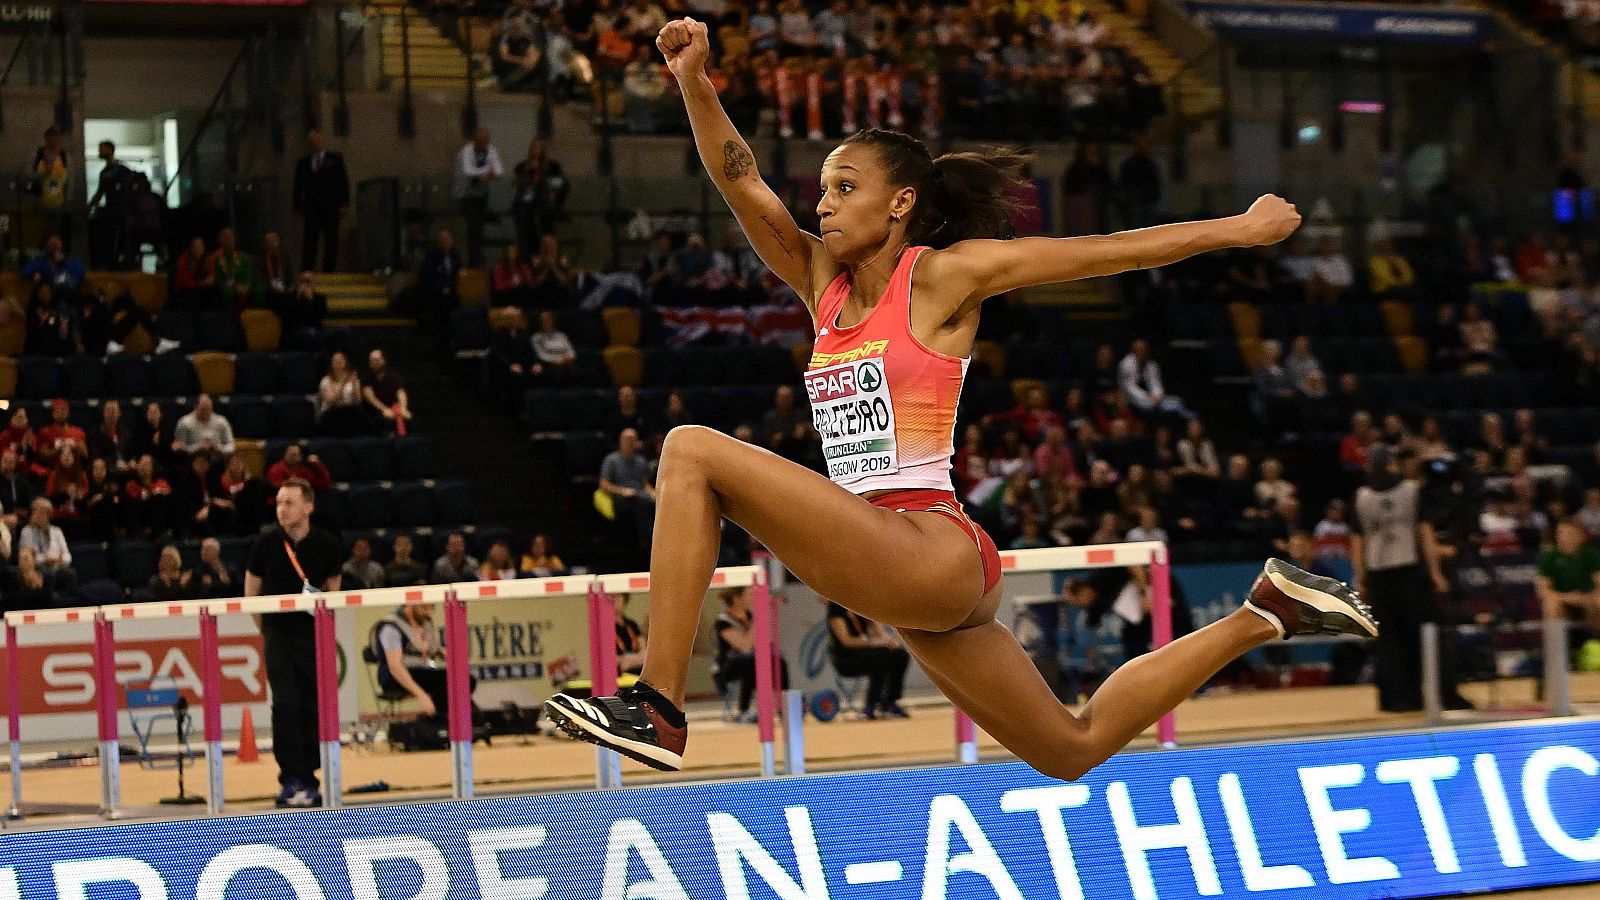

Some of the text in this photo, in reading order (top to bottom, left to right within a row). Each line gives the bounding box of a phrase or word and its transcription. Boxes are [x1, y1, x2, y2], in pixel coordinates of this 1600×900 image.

[805, 370, 855, 399] SPAR
[861, 456, 891, 472] 2019
[42, 644, 262, 705] SPAR
